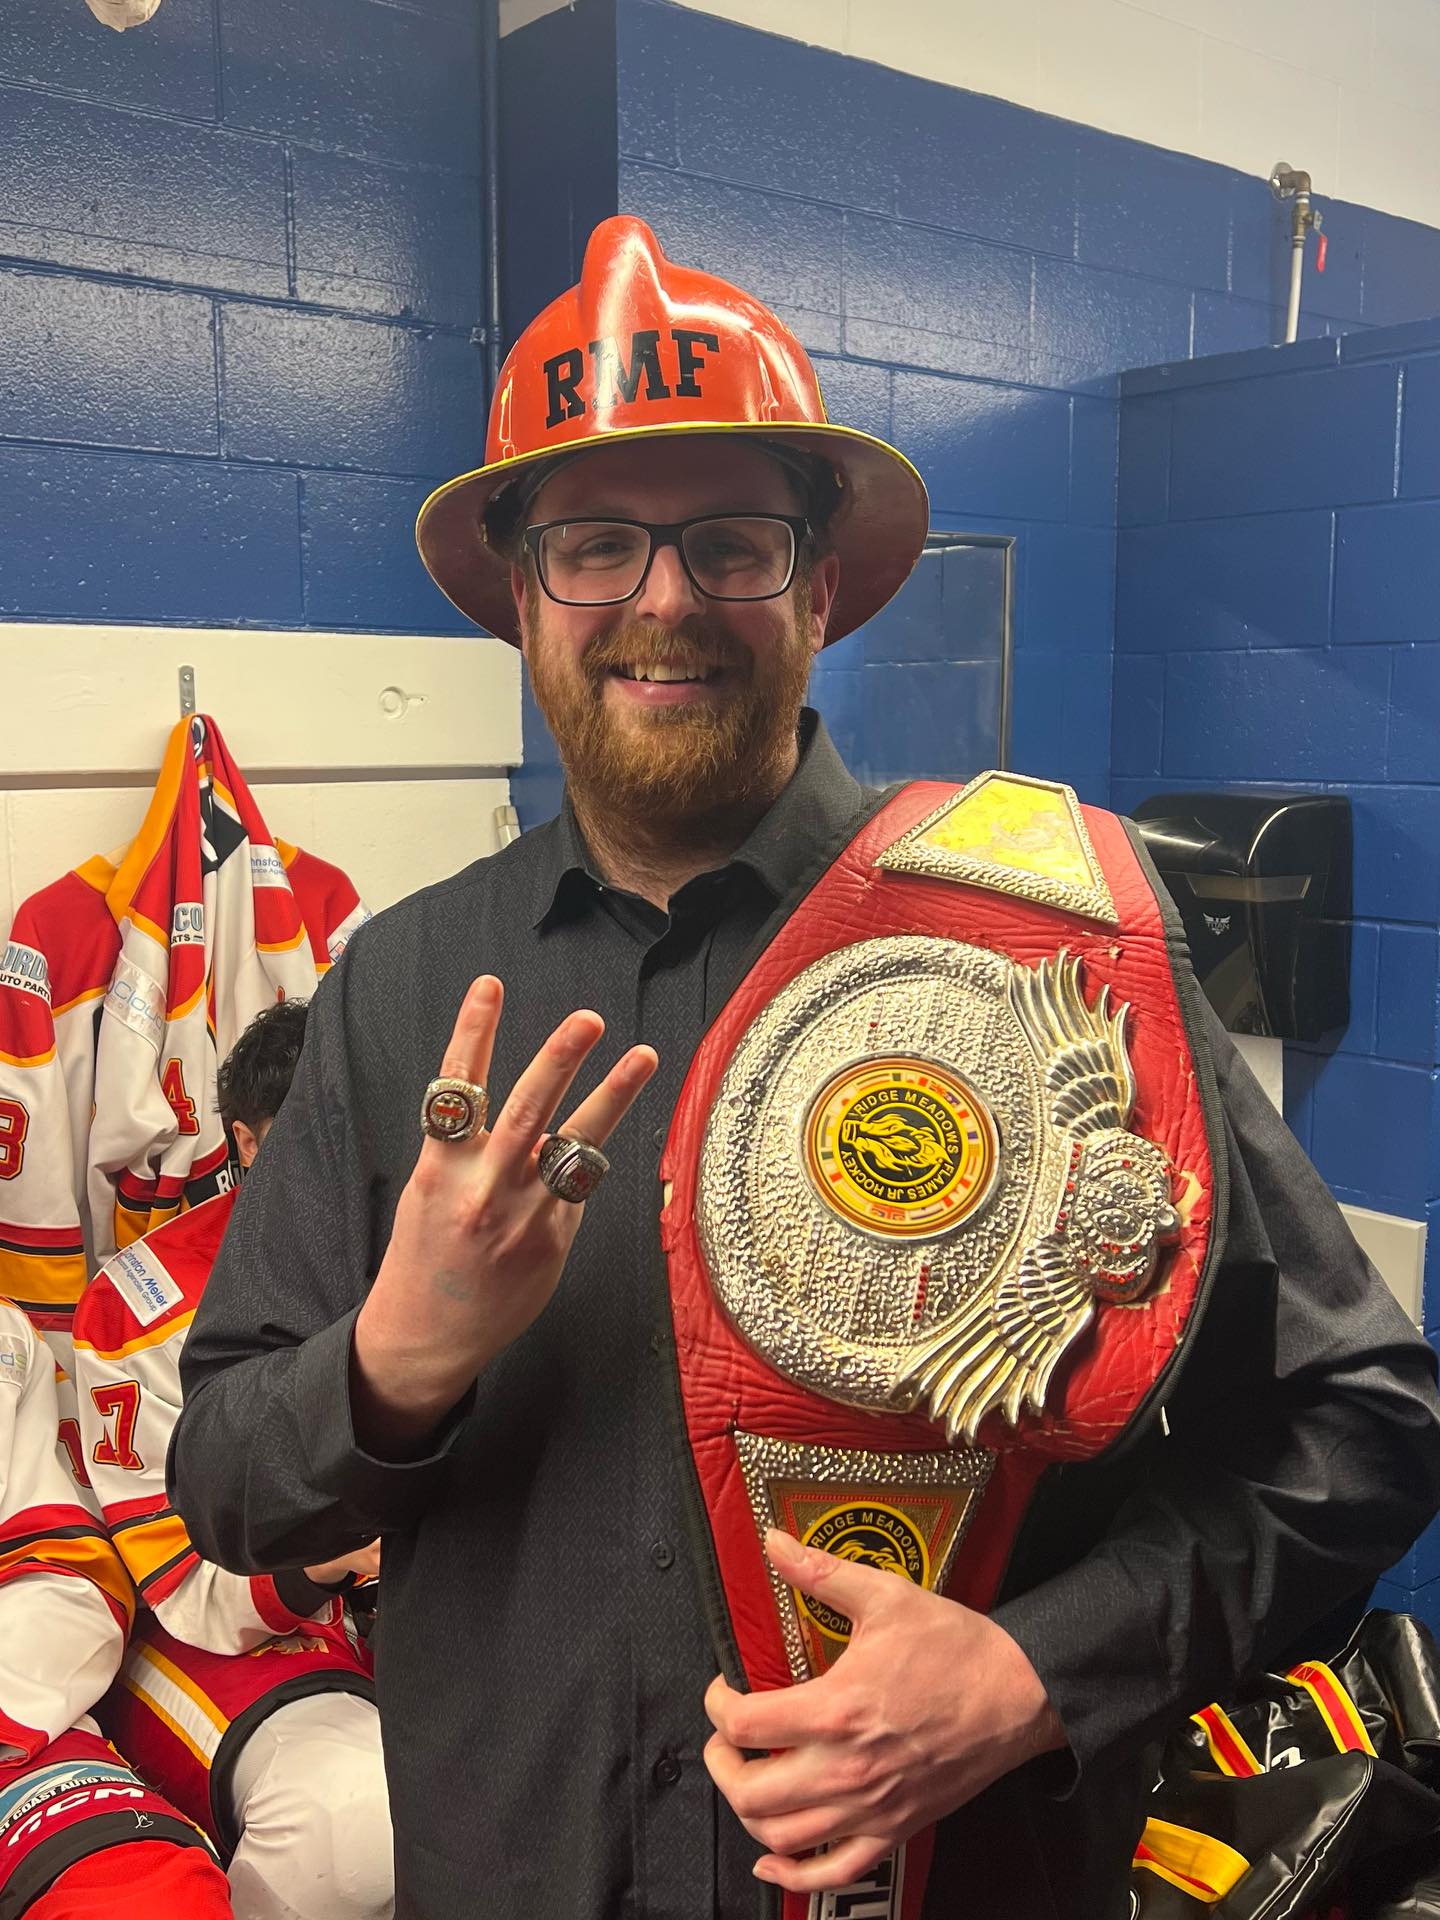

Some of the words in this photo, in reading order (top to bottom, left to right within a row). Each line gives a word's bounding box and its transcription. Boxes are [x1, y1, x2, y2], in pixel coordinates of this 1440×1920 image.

[543, 328, 721, 430] RMF
[160, 1057, 200, 1136] 4
[852, 1089, 900, 1116] RIDGE
[904, 1090, 960, 1155] MEADOWS
[841, 1150, 883, 1197] HOCKEY
[887, 1189, 905, 1201] JR
[907, 1161, 954, 1201] FLAMES
[141, 1277, 168, 1307] Meier
[811, 1512, 856, 1548] RIDGE
[862, 1510, 921, 1572] MEADOWS
[13, 1789, 57, 1821] COAST
[60, 1776, 97, 1791] AUTO
